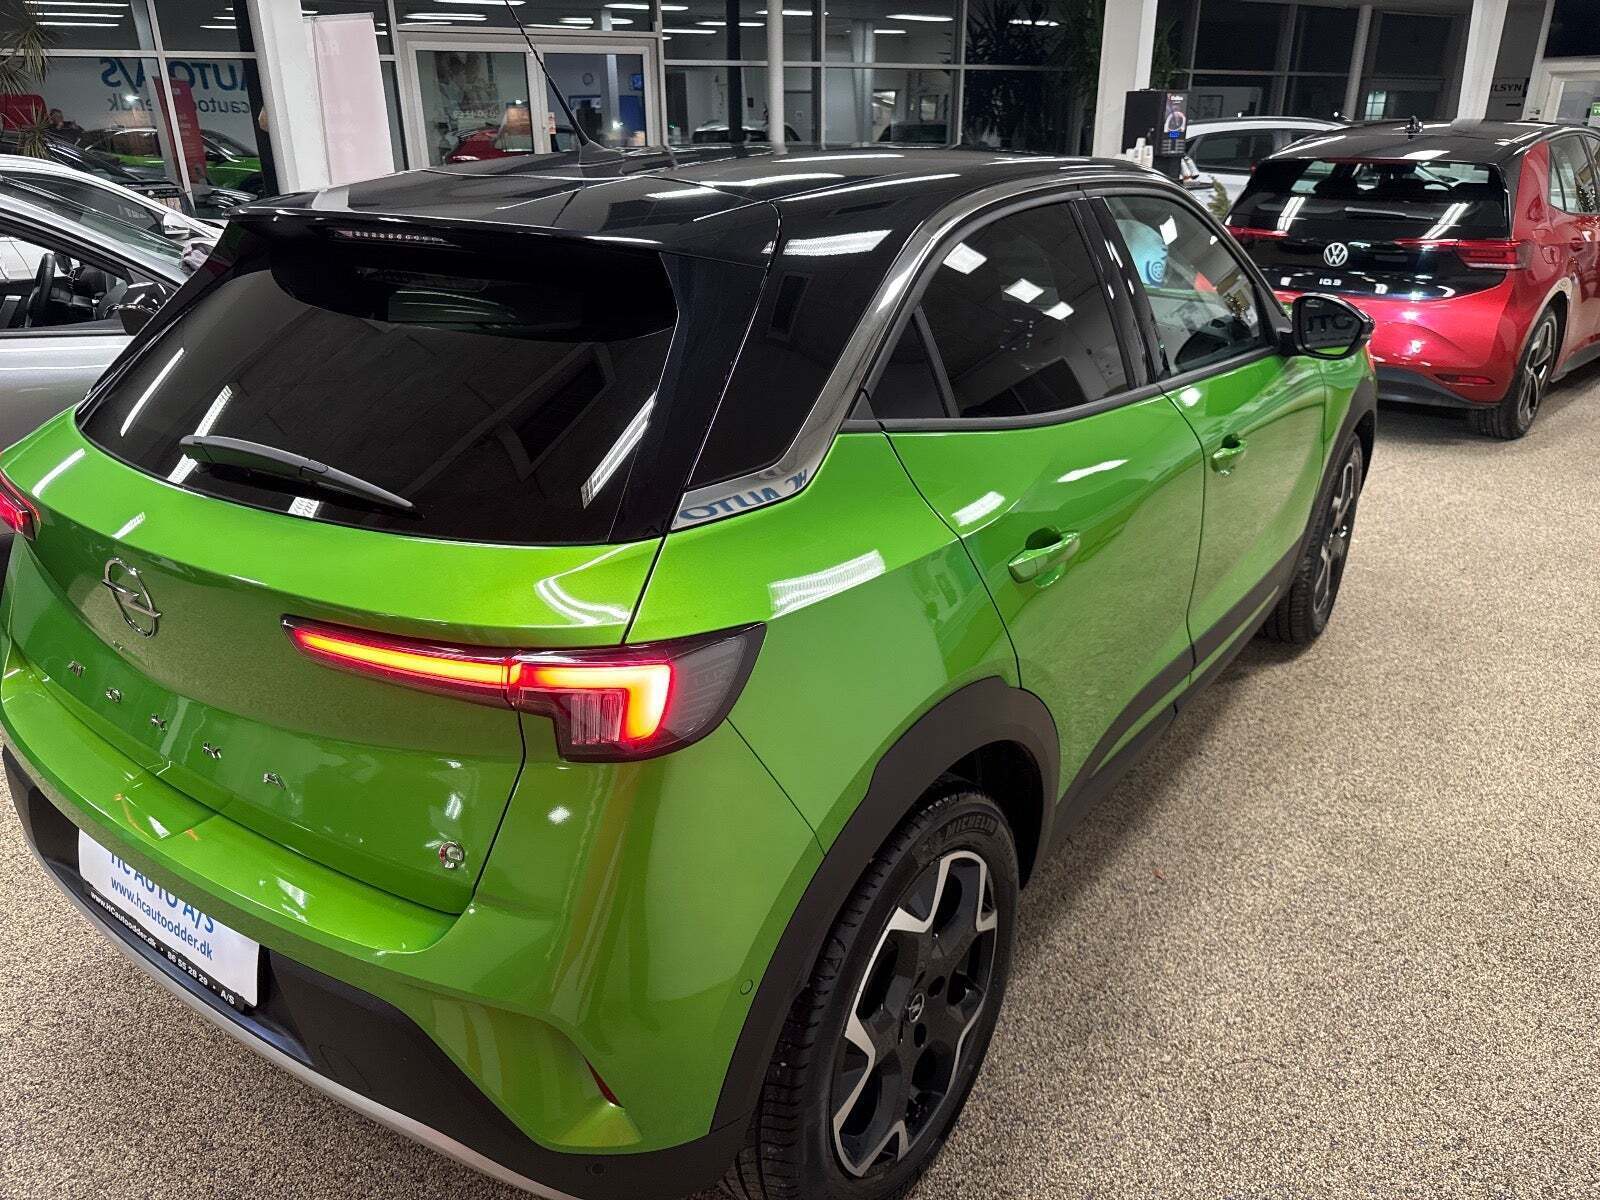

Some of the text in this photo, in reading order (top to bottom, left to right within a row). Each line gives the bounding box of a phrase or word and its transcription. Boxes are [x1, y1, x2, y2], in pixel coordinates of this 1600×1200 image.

[1491, 83, 1522, 92] LSYN
[111, 876, 213, 961] www.hcautoodder.dk
[182, 903, 214, 933] A/S
[220, 988, 235, 1005] A/S
